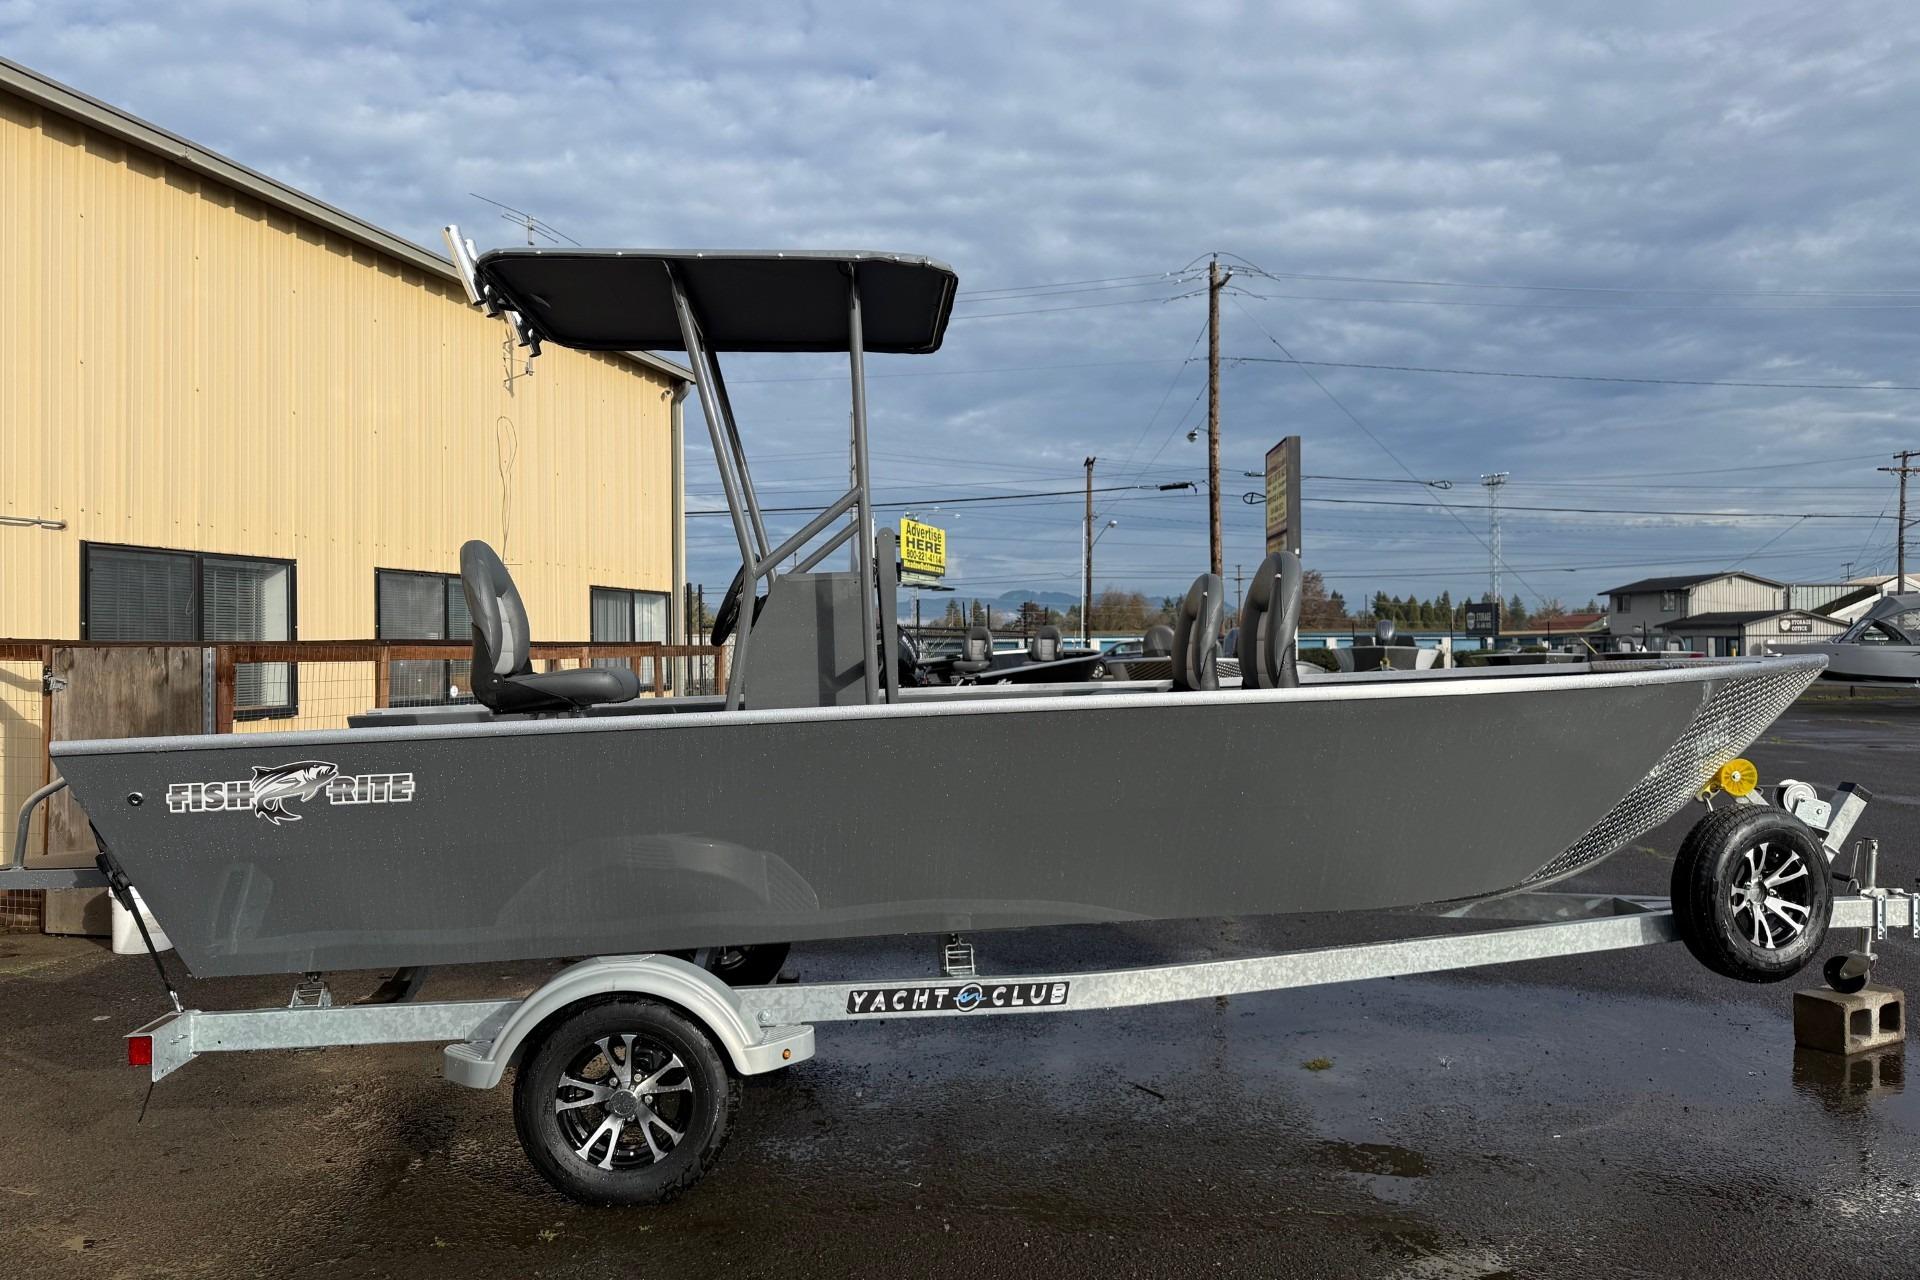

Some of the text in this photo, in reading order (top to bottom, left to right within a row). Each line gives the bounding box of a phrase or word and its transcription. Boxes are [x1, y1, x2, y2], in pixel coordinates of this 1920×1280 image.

[906, 521, 942, 543] Advertise
[906, 536, 942, 555] HERE
[166, 773, 415, 813] FISH RITE
[852, 983, 1066, 1012] YACHT CLUB
